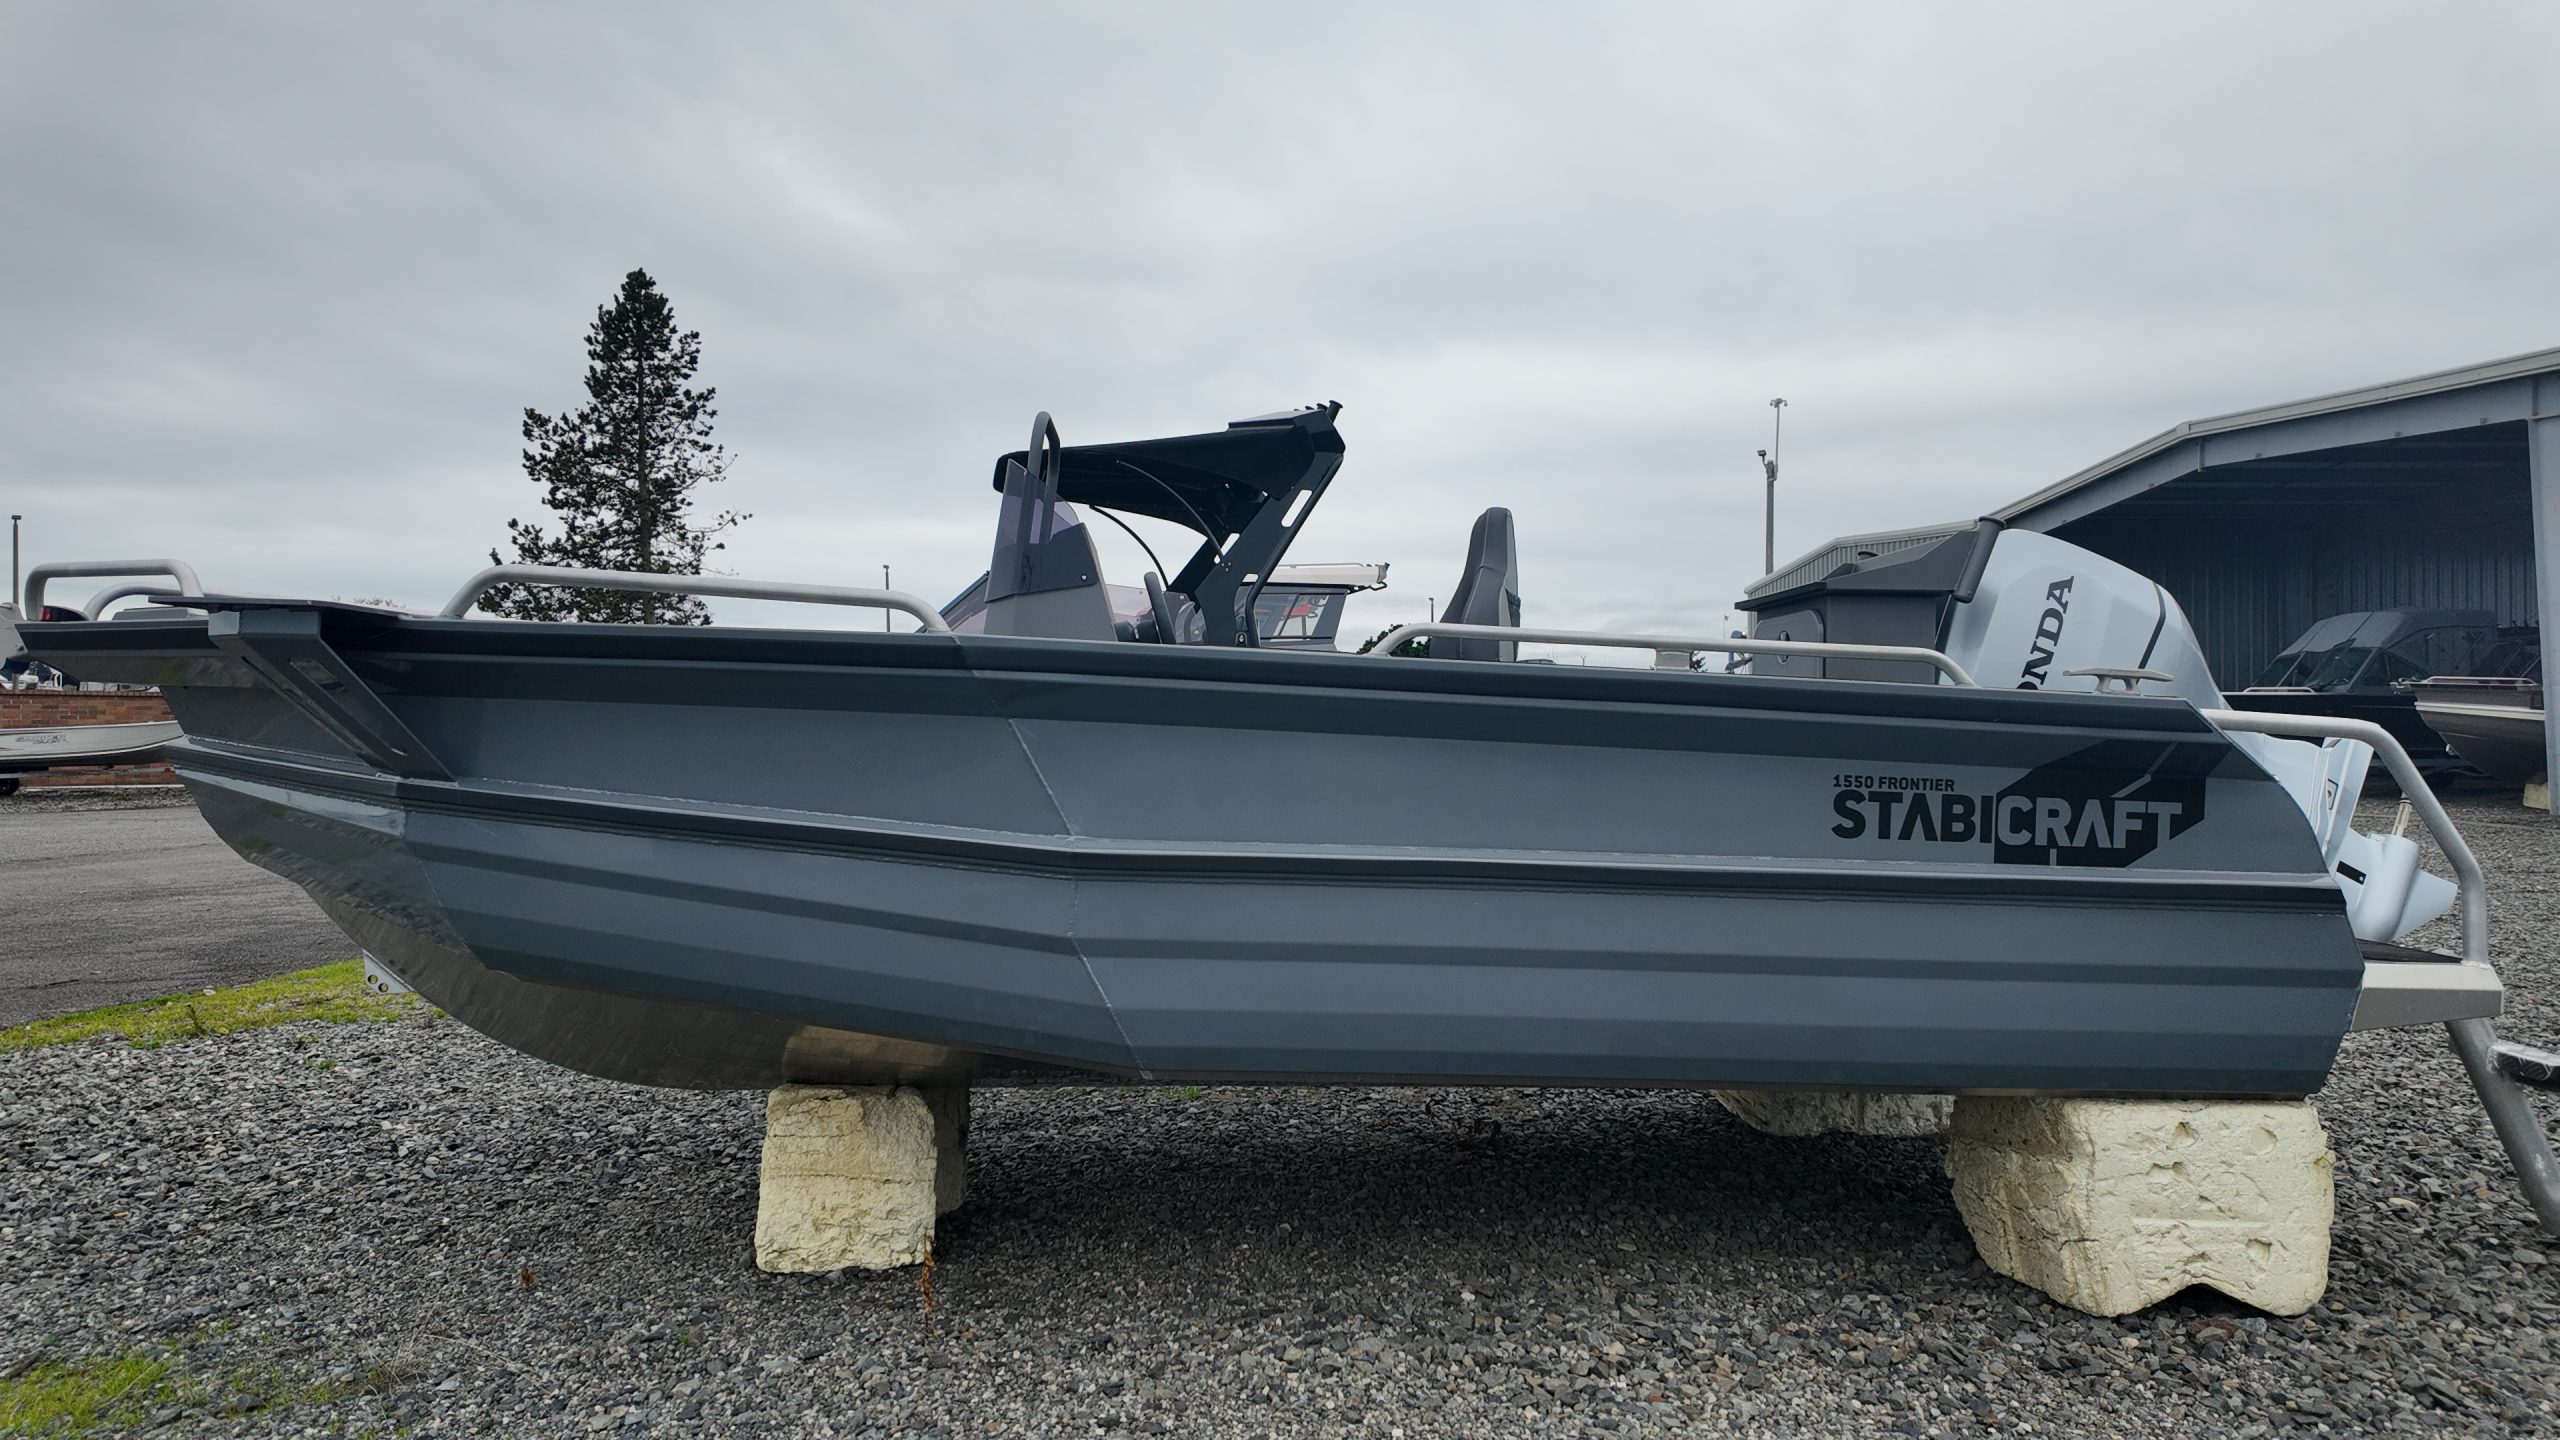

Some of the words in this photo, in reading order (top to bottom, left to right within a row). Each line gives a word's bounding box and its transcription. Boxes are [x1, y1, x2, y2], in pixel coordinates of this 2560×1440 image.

[2016, 575, 2075, 690] NDA
[1833, 774, 1875, 790] 1550
[1878, 776, 1955, 793] FRONTIER
[1831, 789, 2183, 849] STABICRAFT
